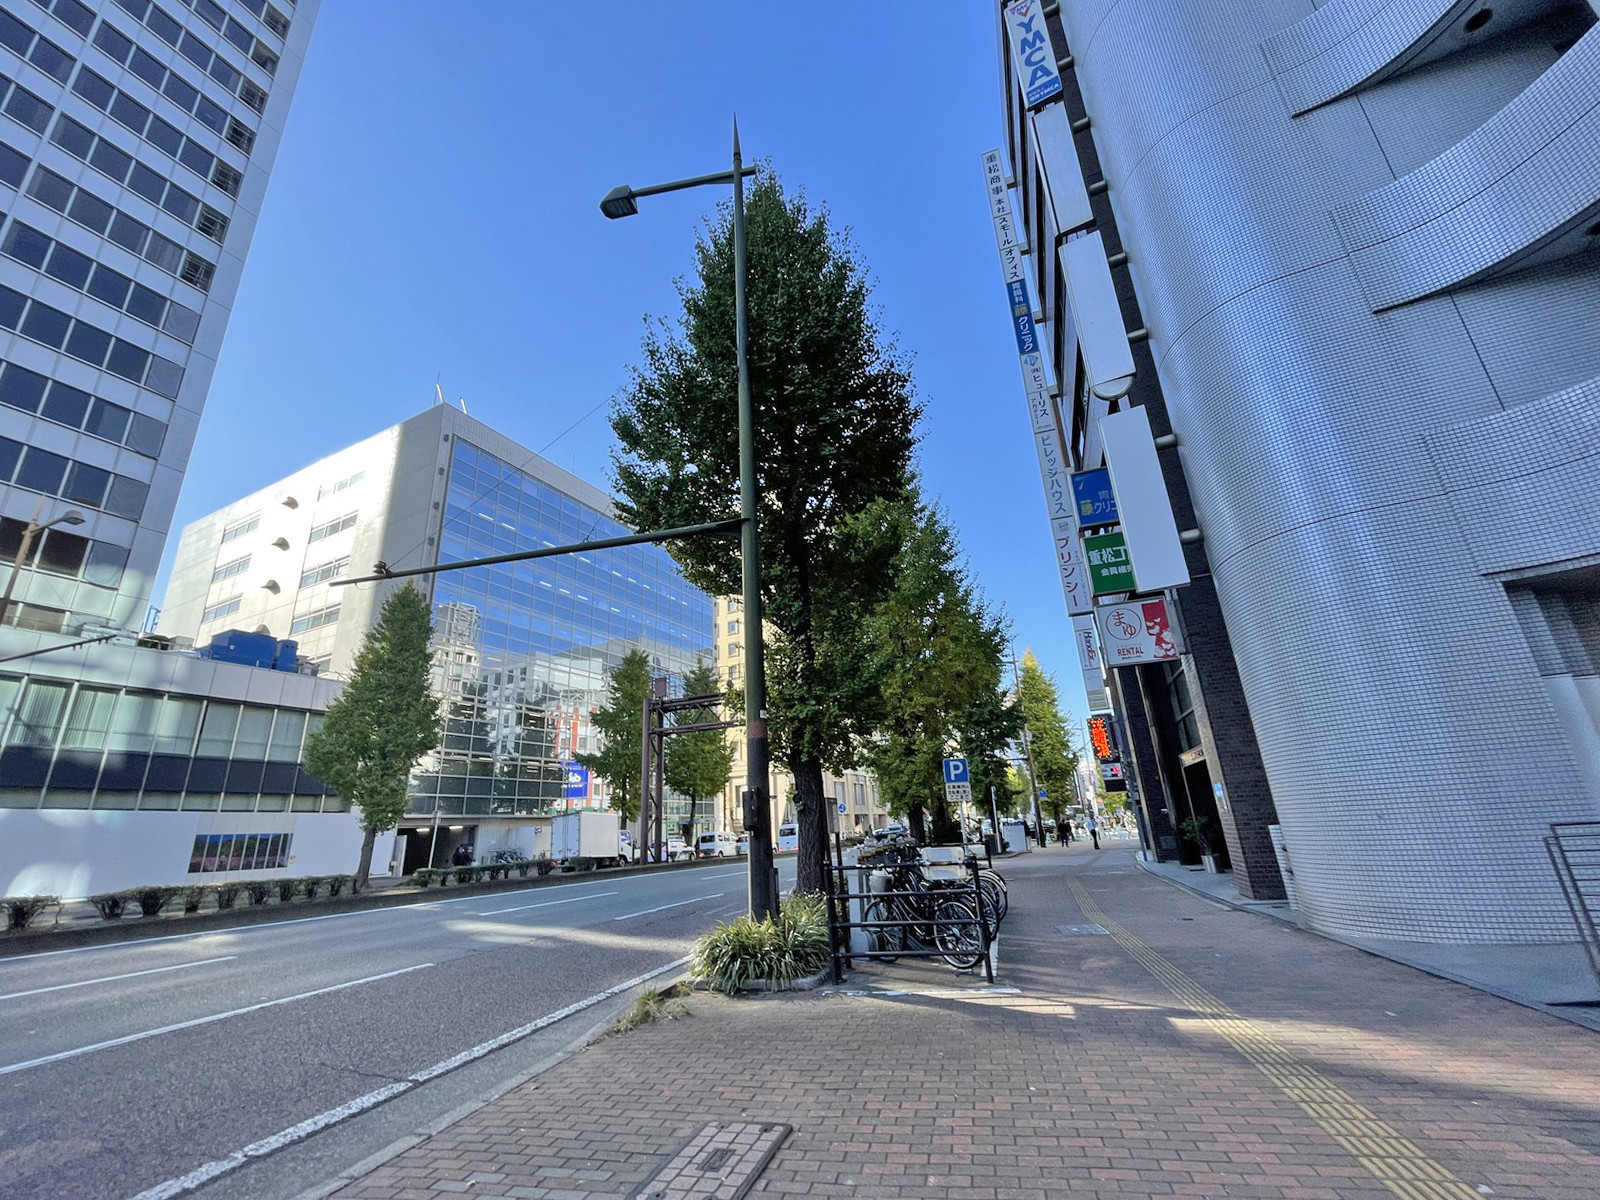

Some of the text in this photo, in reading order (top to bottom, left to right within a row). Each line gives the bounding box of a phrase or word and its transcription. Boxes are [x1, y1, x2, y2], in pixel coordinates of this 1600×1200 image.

[1017, 13, 1054, 88] YMCA
[1042, 434, 1066, 514] ビレッジハウス
[1117, 646, 1144, 657] RENTAL
[950, 760, 964, 780] P
